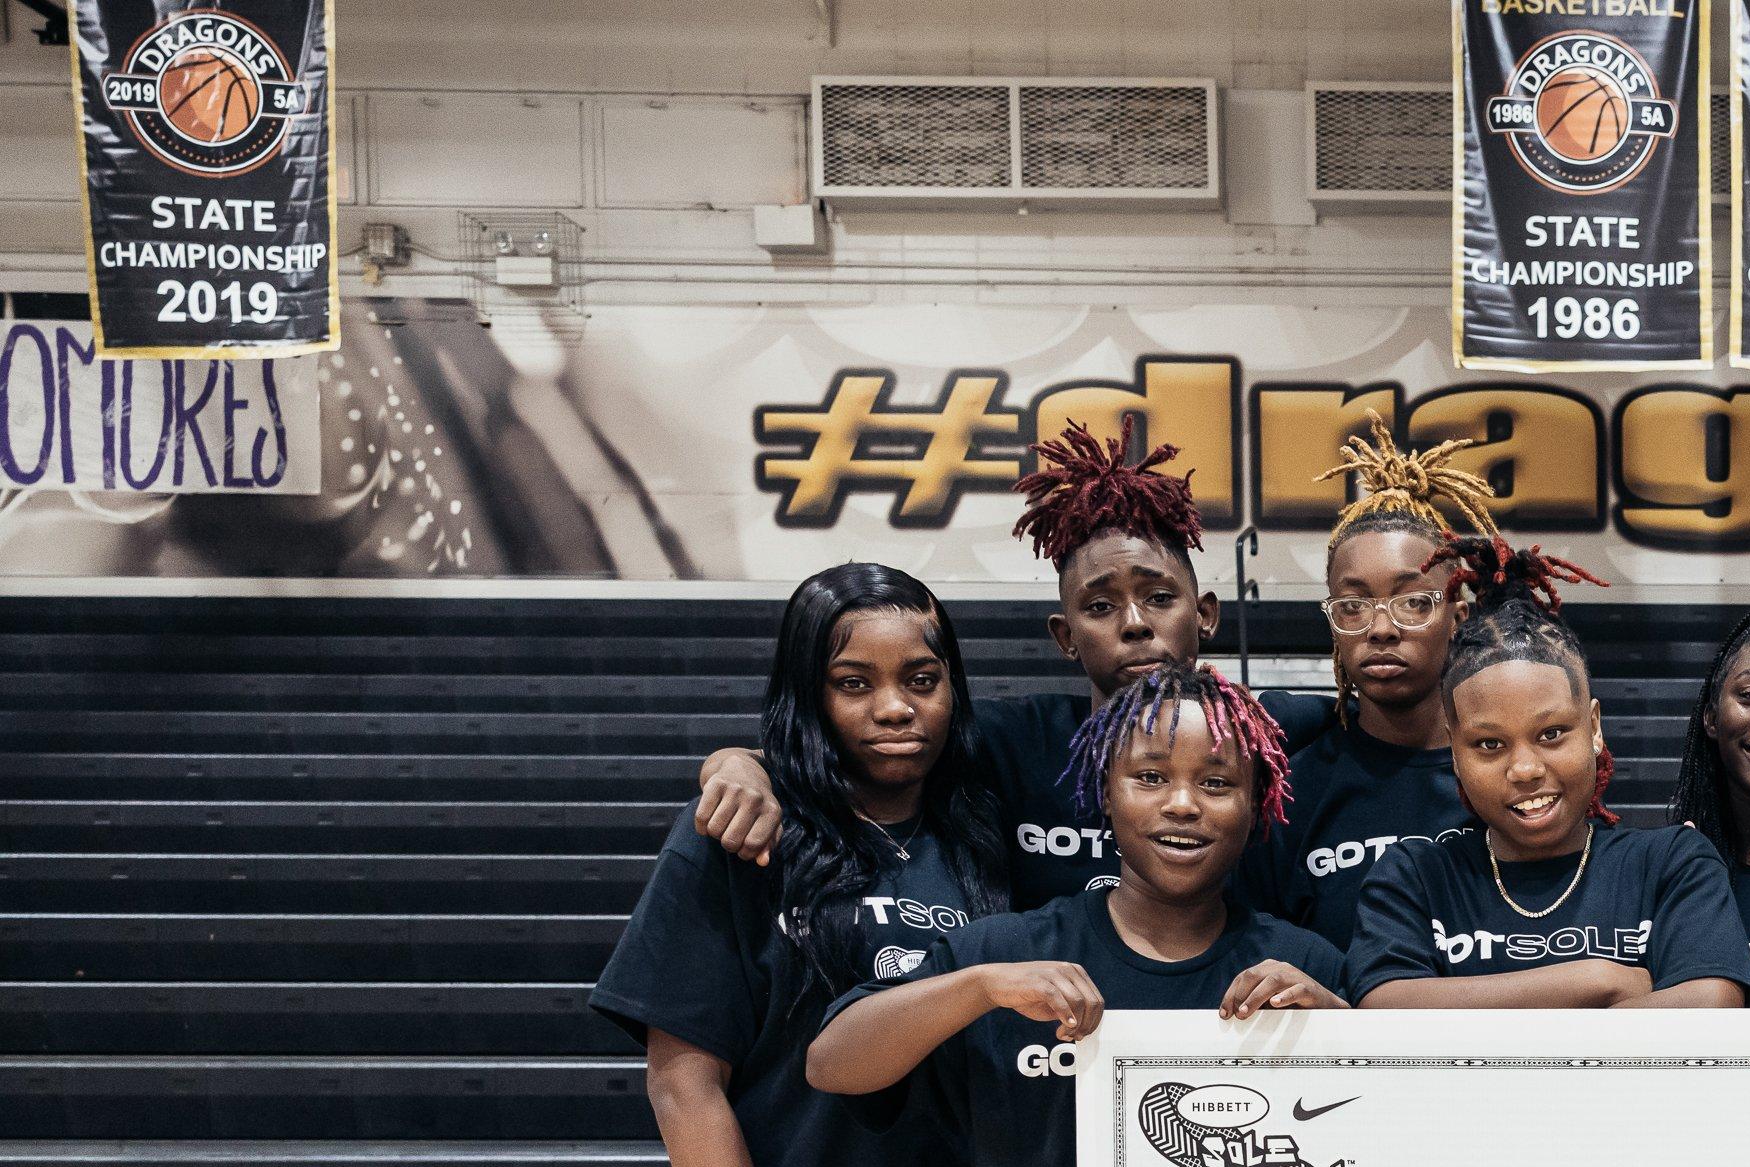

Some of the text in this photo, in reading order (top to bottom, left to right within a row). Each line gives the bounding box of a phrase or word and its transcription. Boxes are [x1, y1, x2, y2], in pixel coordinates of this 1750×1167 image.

[139, 18, 276, 76] DRAGONS
[1518, 39, 1646, 94] DRAGONS
[108, 81, 299, 110] 2019 5A
[1492, 104, 1666, 128] 1986 5A
[151, 196, 277, 232] STATE
[1525, 215, 1641, 250] STATE
[100, 241, 327, 272] CHAMPIONSHIP
[1471, 258, 1694, 289] CHAMPIONSHIP
[157, 280, 279, 324] 2019
[1527, 297, 1641, 340] 1986
[1017, 823, 1122, 858] GOT
[1192, 1102, 1251, 1112] HIBBETT
